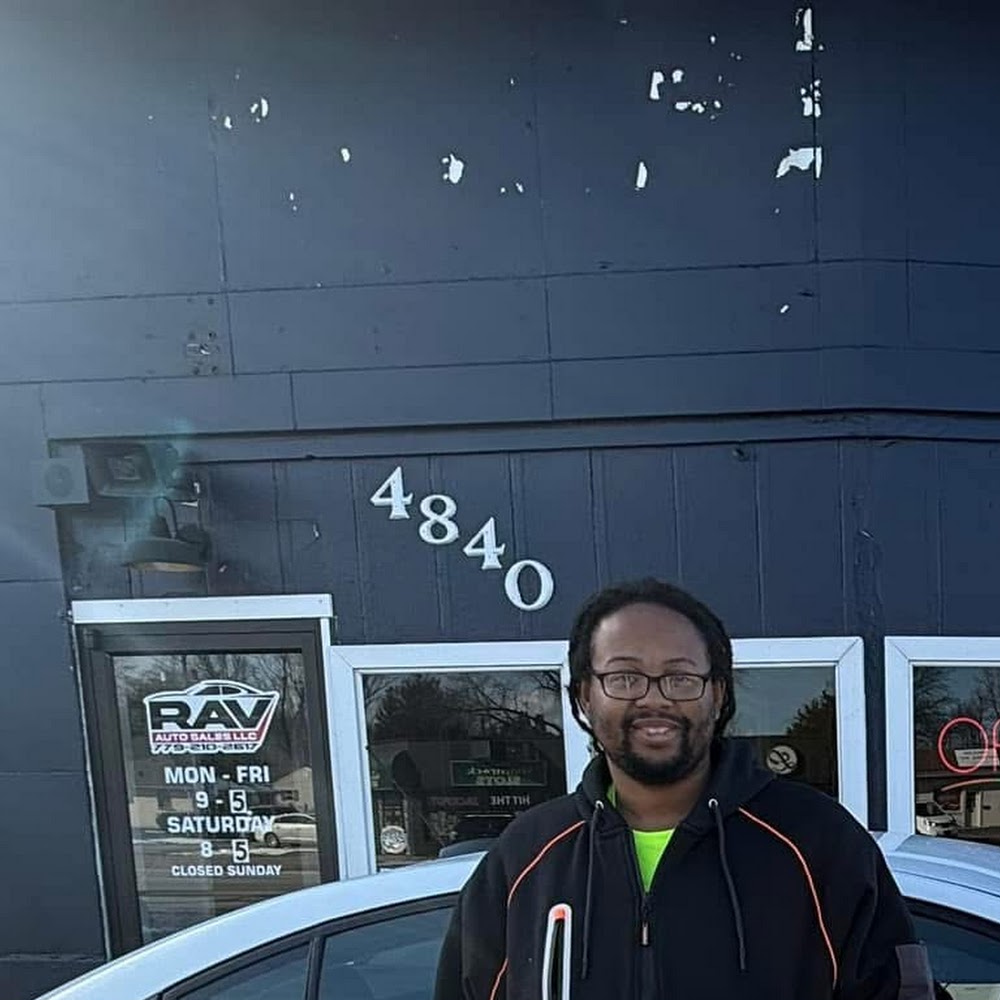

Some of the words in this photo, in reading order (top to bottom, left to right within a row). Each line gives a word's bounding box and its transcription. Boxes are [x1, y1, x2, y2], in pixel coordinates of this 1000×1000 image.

[369, 465, 555, 612] 4840
[149, 699, 271, 730] RAV
[155, 733, 188, 742] AUTO
[190, 732, 231, 742] SALES
[232, 732, 258, 741] LLC
[164, 765, 216, 784] MON
[236, 765, 270, 783] FRI
[195, 791, 209, 808] 9
[231, 790, 246, 811] 5
[167, 815, 274, 834] SATURDAY
[200, 841, 213, 858] 8
[234, 840, 248, 861] 5
[171, 864, 223, 876] CLOSED
[226, 864, 282, 876] SUNDAY
